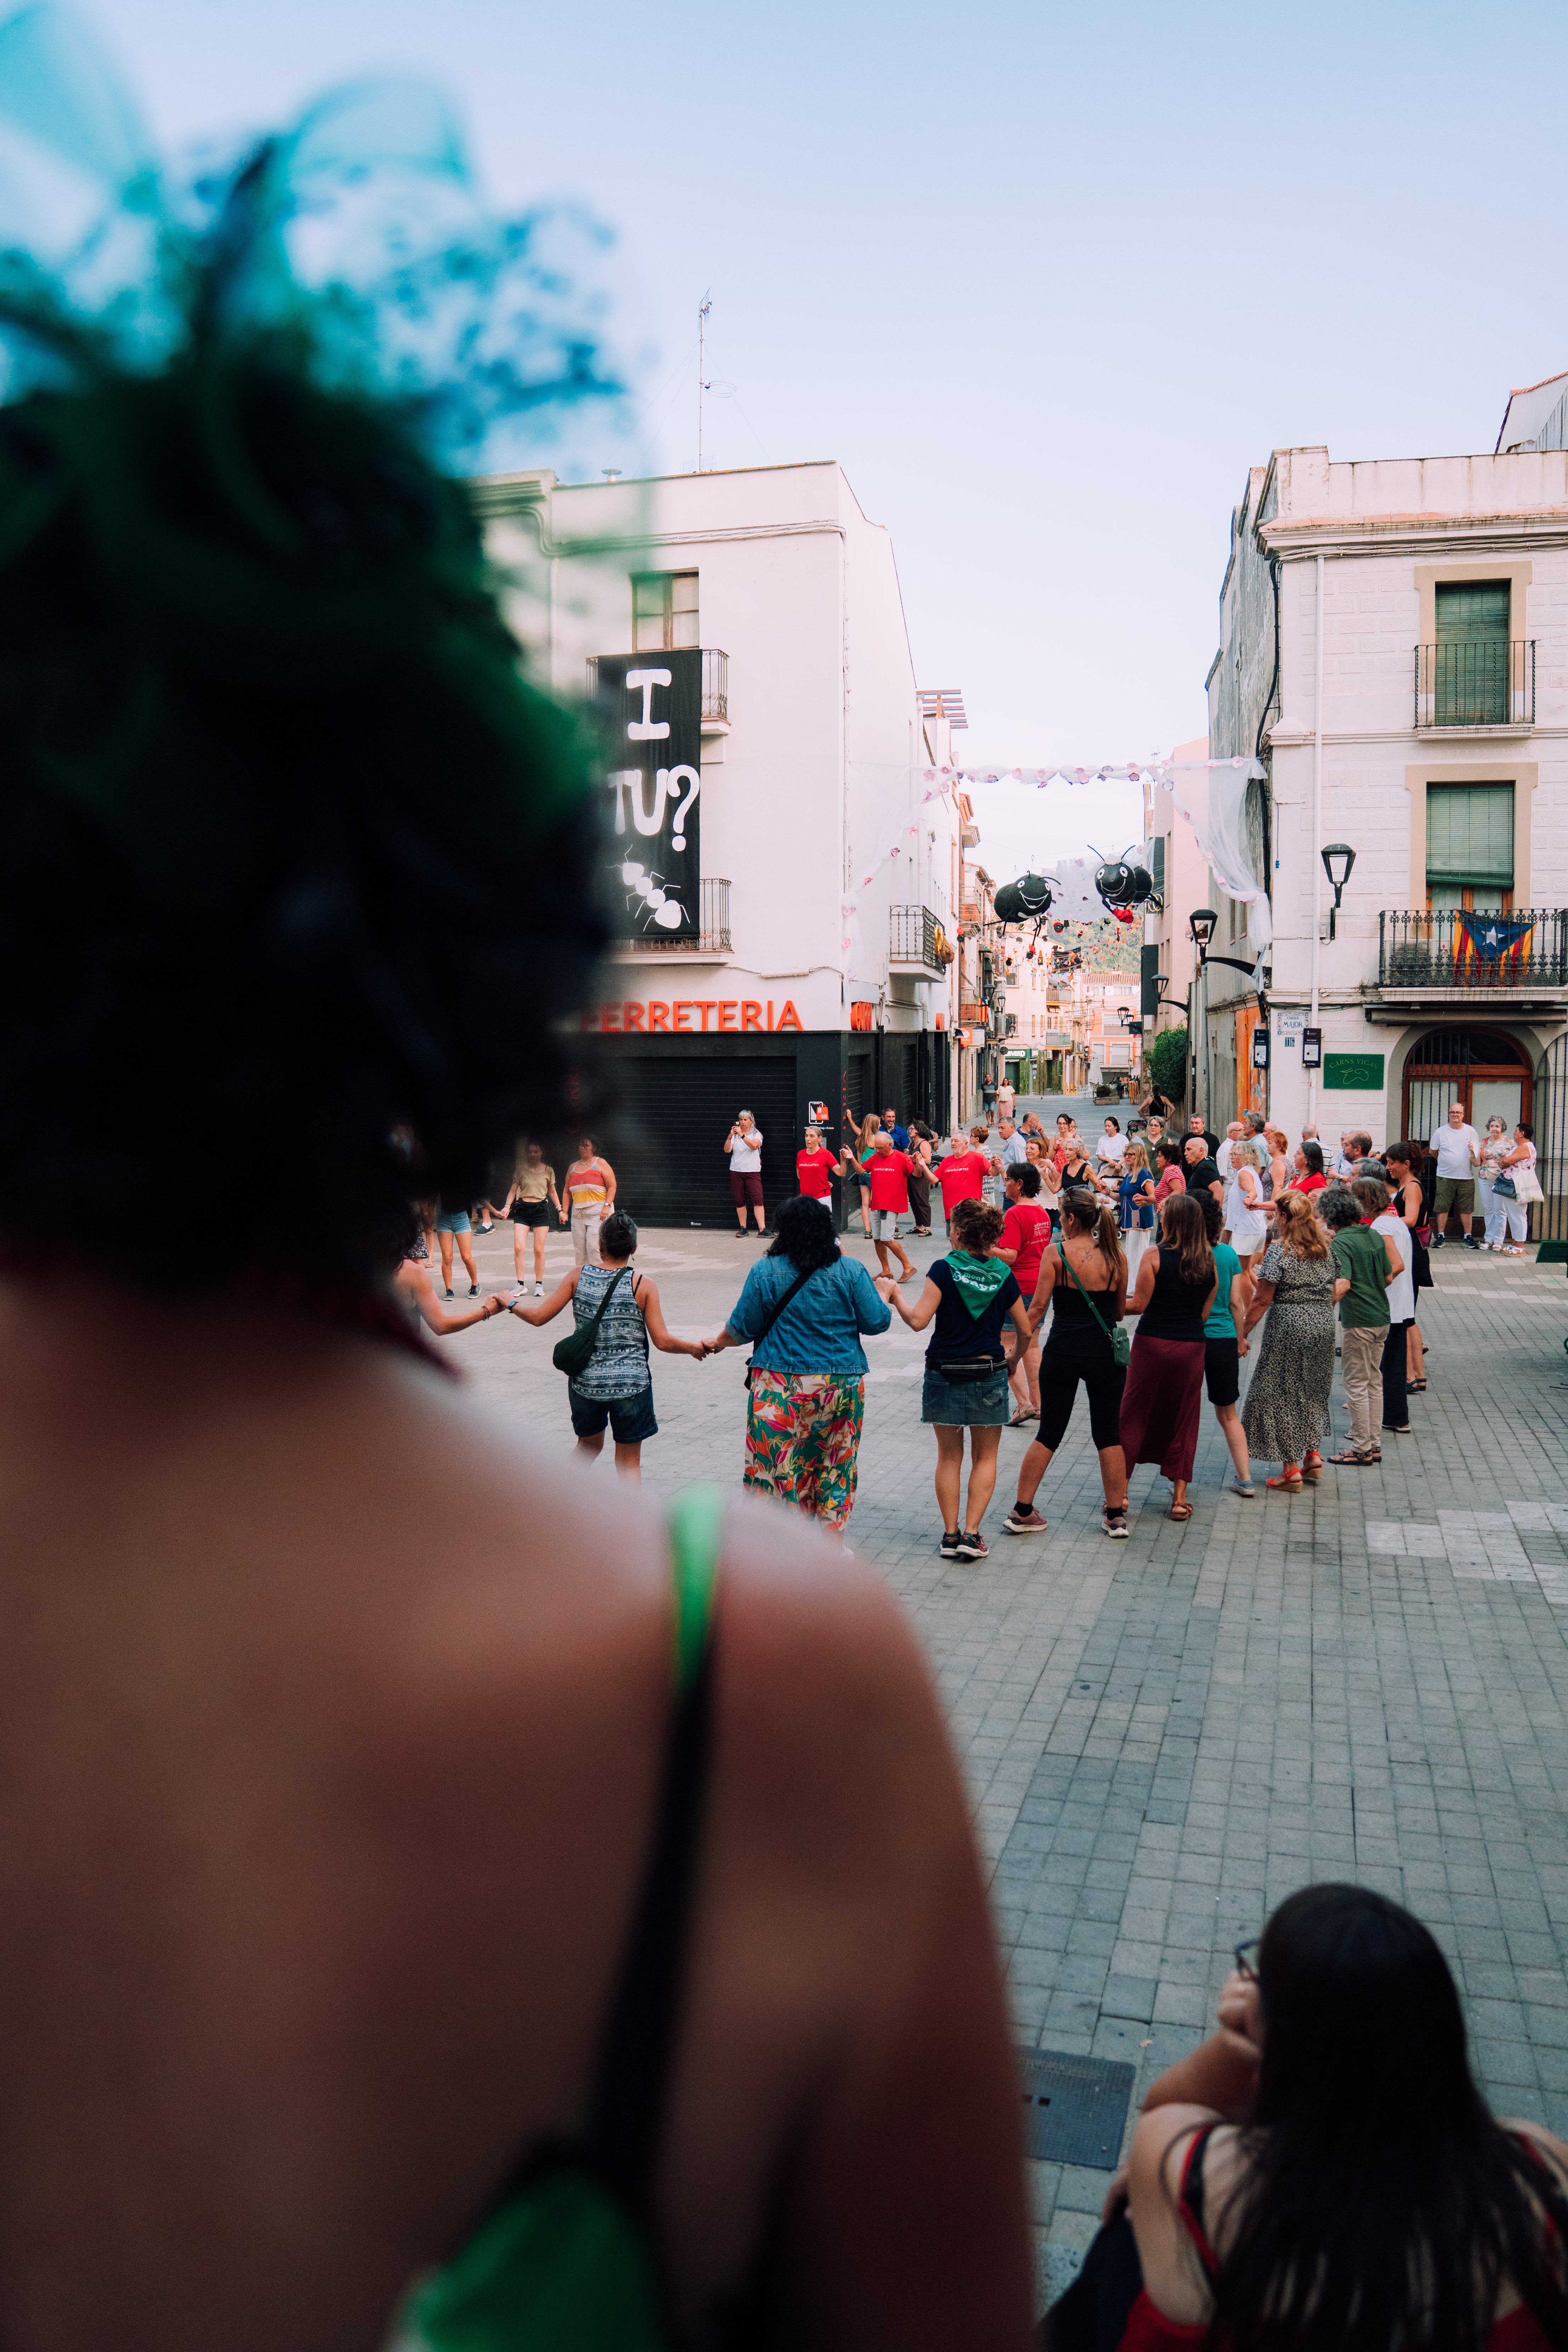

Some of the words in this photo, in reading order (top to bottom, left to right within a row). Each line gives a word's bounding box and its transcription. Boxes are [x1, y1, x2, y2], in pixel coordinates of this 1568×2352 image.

[626, 668, 672, 740] I
[607, 764, 700, 852] TU?
[1285, 1038, 1294, 1046] 116
[1329, 1058, 1354, 1068] CARNS
[1357, 1058, 1378, 1069] VIGAS
[963, 1272, 985, 1282] mont
